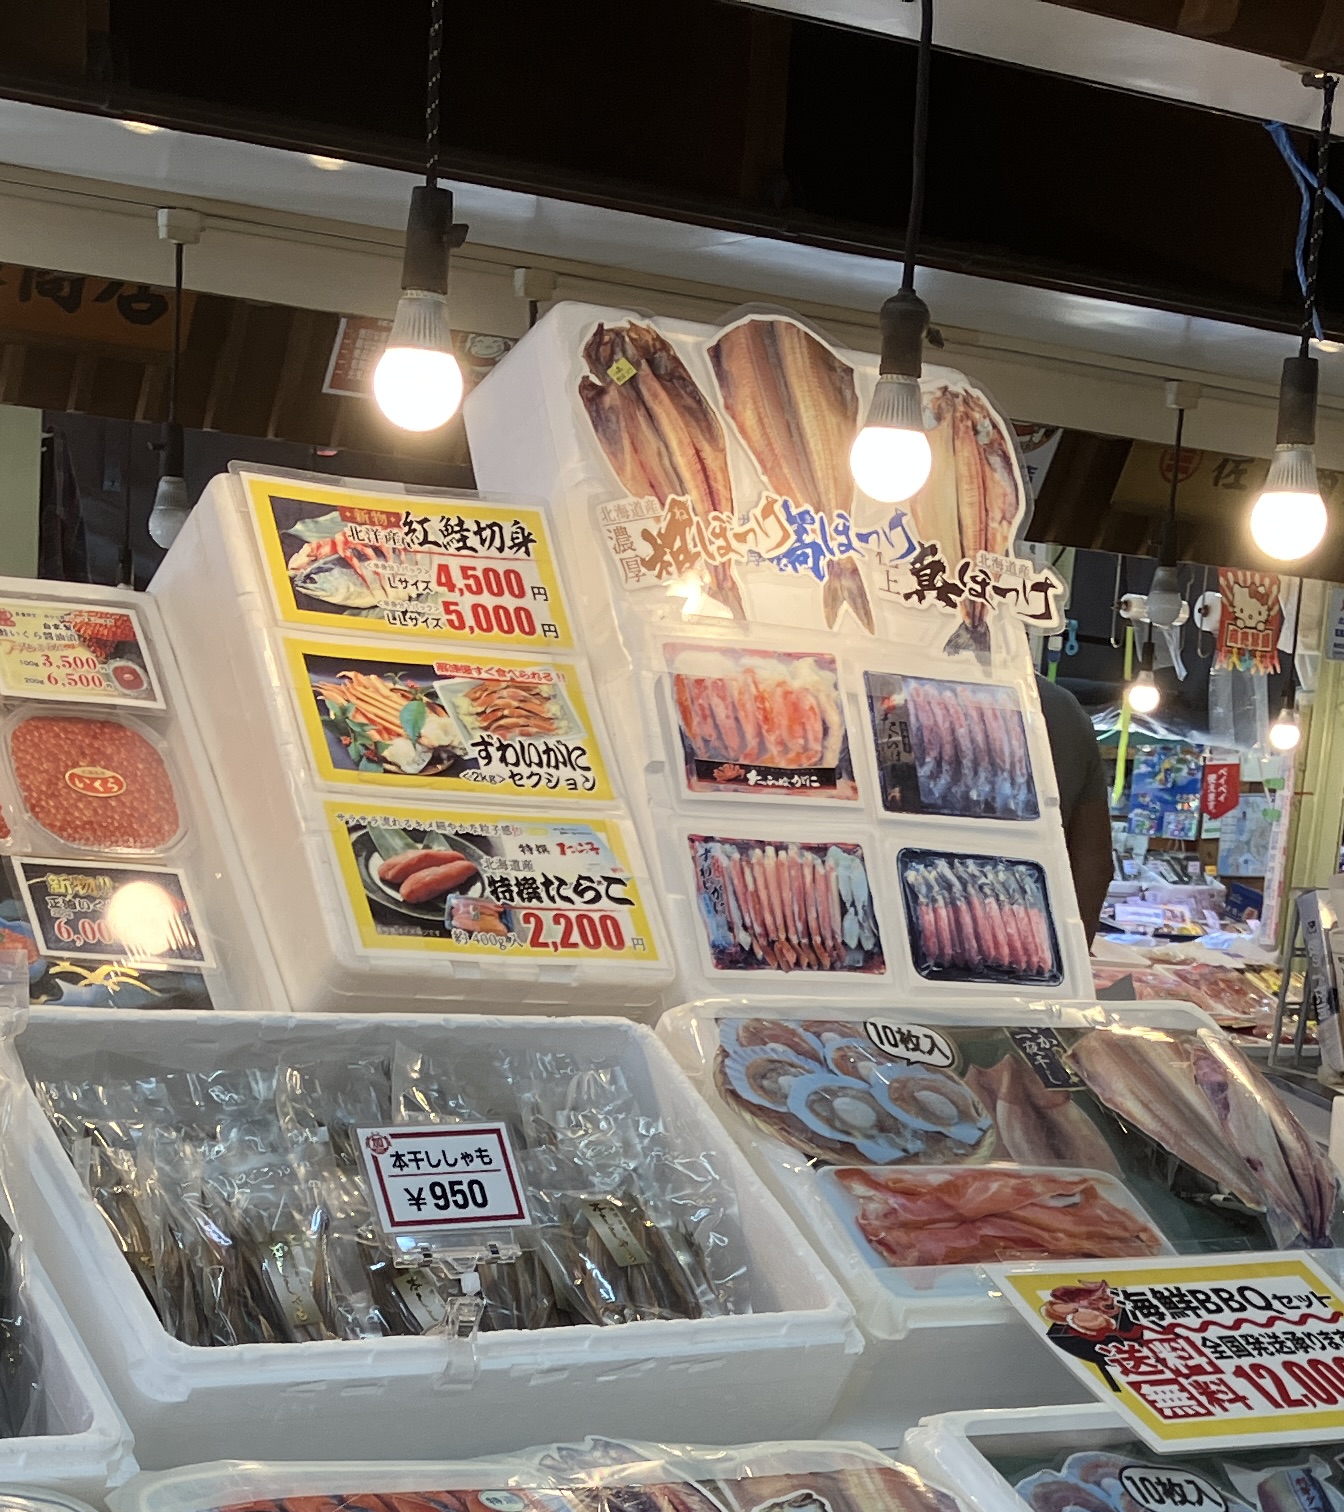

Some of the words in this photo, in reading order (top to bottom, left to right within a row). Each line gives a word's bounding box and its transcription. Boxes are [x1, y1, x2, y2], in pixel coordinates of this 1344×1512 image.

[600, 498, 660, 522] 北海道産
[402, 511, 537, 557] 紅鮭切身
[607, 526, 646, 584] 濃厚
[388, 576, 433, 593] Lサイズ
[436, 563, 548, 602] 4,500円
[441, 600, 559, 638] 5,000円
[471, 735, 592, 772] ずわいがに
[74, 777, 119, 793] いくら
[508, 771, 596, 791] セクション
[483, 857, 534, 872] 北海道産
[522, 912, 646, 953] 2,200円
[870, 1022, 950, 1061] 10枚入
[389, 1146, 494, 1172] 本干ししゃも
[403, 1178, 490, 1212] ¥950
[1114, 1285, 1334, 1331] 海鮮BBQセット
[1096, 1335, 1217, 1380] 送料
[1136, 1374, 1247, 1419] 無料
[1125, 1475, 1222, 1508] 10枚入
